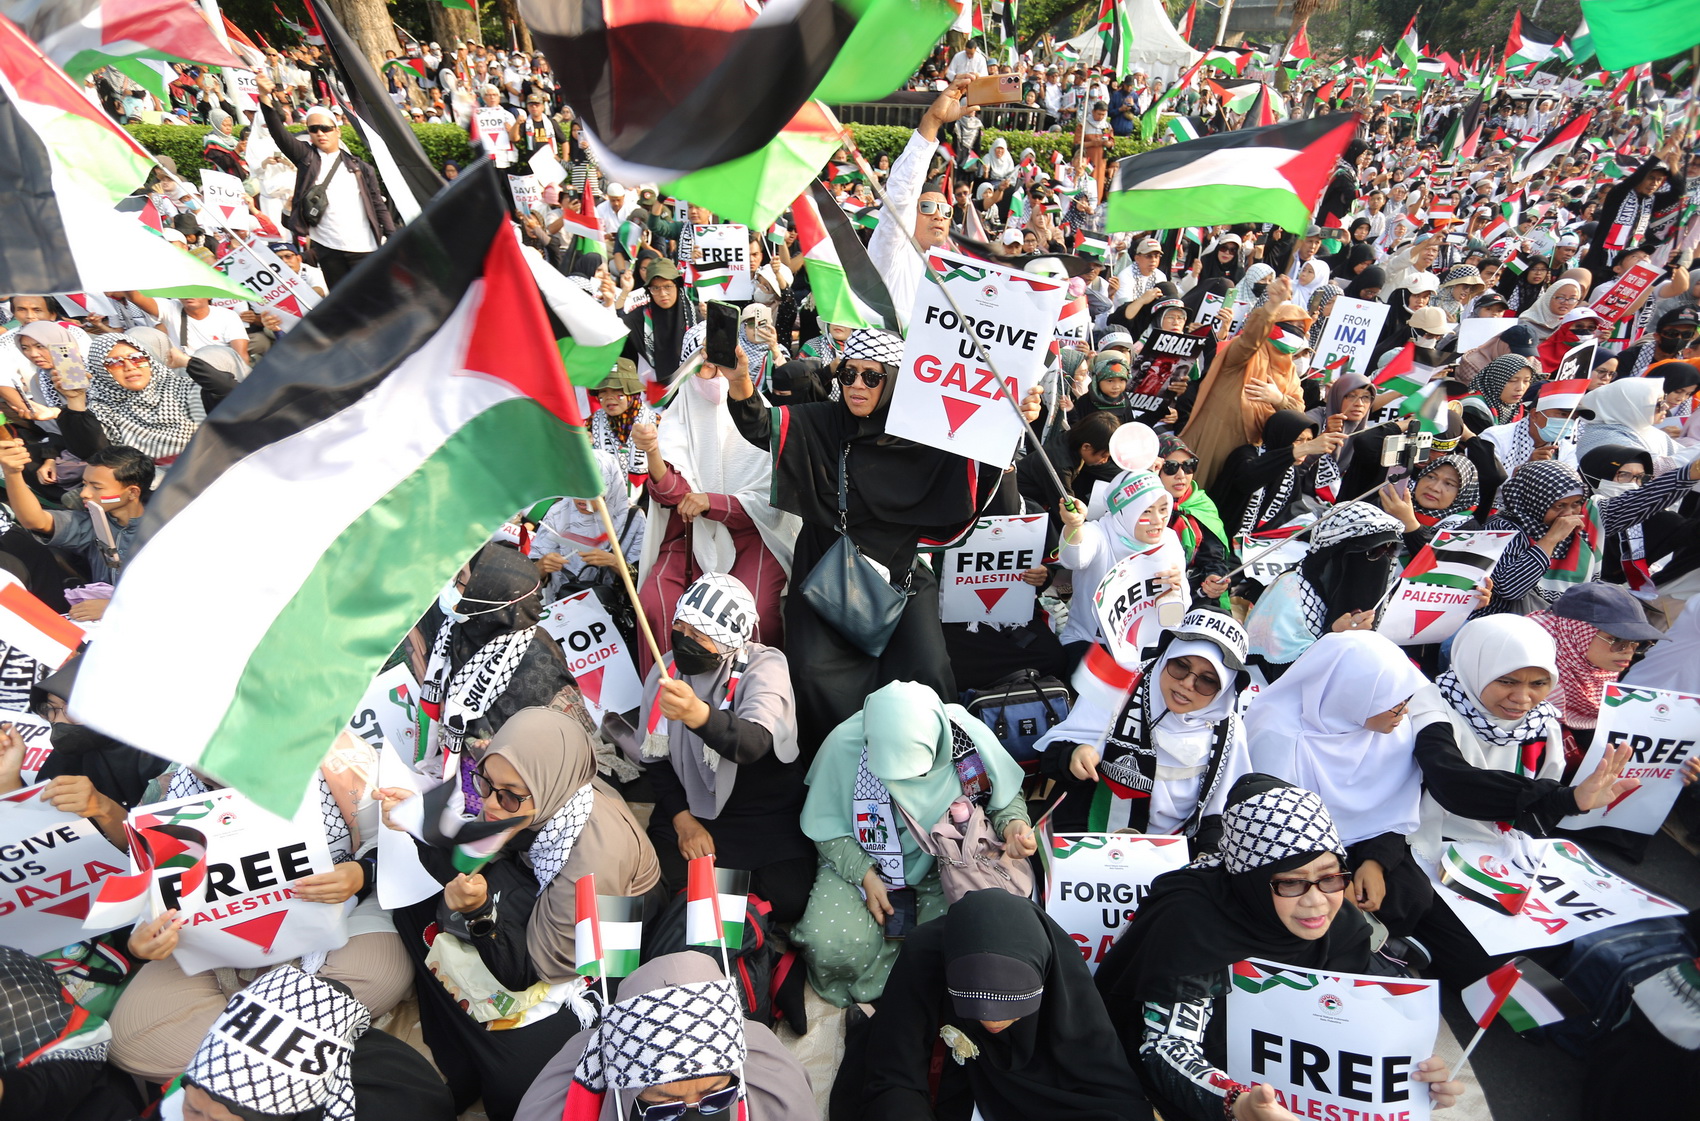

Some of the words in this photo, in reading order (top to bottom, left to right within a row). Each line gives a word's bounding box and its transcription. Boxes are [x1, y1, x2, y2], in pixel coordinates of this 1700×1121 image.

[480, 119, 503, 127] STOP
[513, 186, 537, 194] SAVE
[702, 247, 744, 262] FREE
[240, 263, 282, 293] TOP
[925, 305, 1038, 351] FORGIVE
[1200, 313, 1239, 333] FRE
[1342, 314, 1371, 328] FROM
[1153, 333, 1195, 357] ISRAEL
[1334, 324, 1367, 345] INA
[958, 338, 992, 363] US
[1336, 344, 1356, 355] FOR
[1323, 353, 1356, 373] PL
[913, 354, 1019, 404] GAZA
[1123, 479, 1145, 497] FREE
[957, 549, 1034, 573] FREE
[955, 573, 1023, 585] PALESTIN
[1107, 577, 1163, 637] FREE
[1401, 589, 1472, 605] PALESTINE
[1117, 599, 1158, 649] PALESTIN
[1182, 613, 1204, 628] SAVE
[555, 622, 607, 657] TOP
[463, 670, 487, 713] SAVE
[1607, 731, 1696, 765] FREE
[1617, 767, 1675, 780] LESTINE
[858, 828, 889, 843] KNRP
[865, 843, 887, 851] JABAR
[158, 842, 314, 911] FREE
[1251, 1028, 1412, 1104] FREE
[1251, 1081, 1410, 1121] ALESTIE
